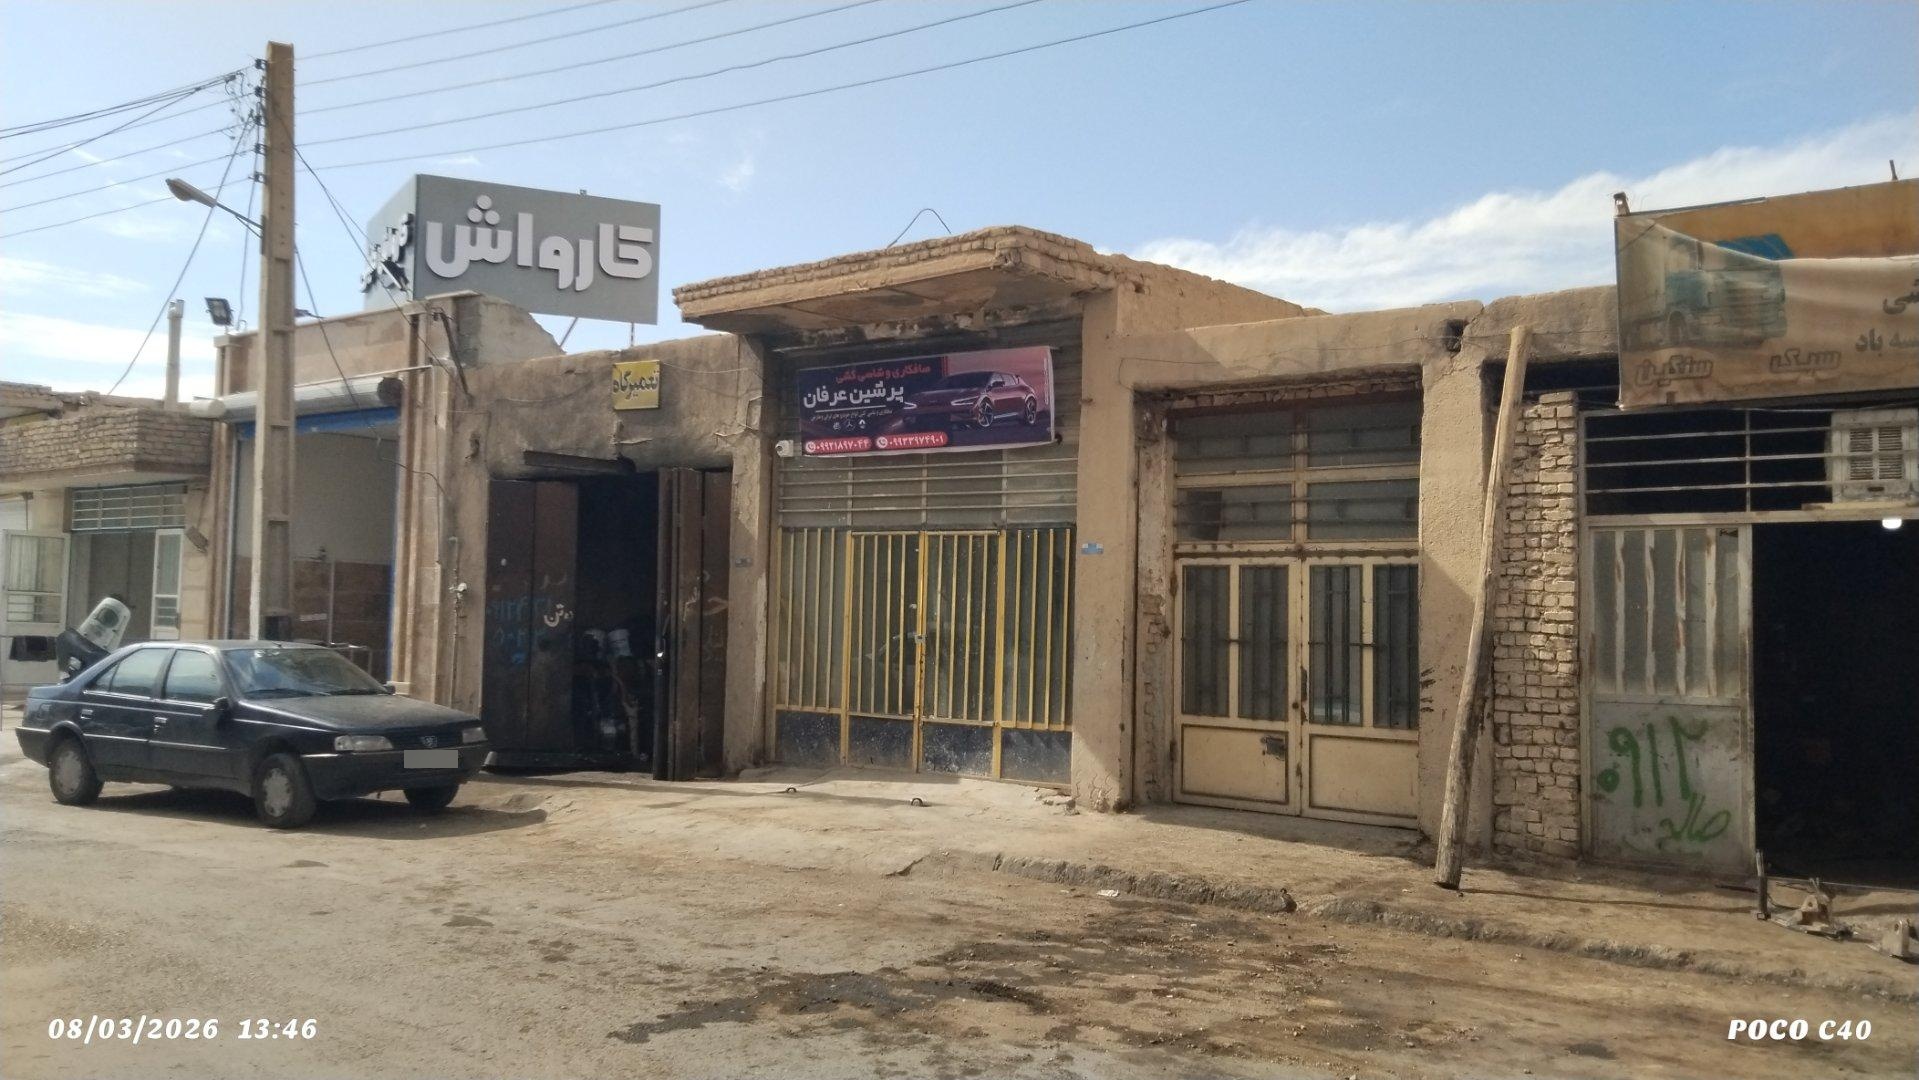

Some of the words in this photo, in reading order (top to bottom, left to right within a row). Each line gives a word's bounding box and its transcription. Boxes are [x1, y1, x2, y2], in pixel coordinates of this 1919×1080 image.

[425, 194, 653, 291] کارواش
[892, 363, 931, 379] صافکاری
[613, 369, 659, 400] تعمیرگاه
[849, 380, 904, 404] پرشین
[803, 385, 847, 409] عرفان
